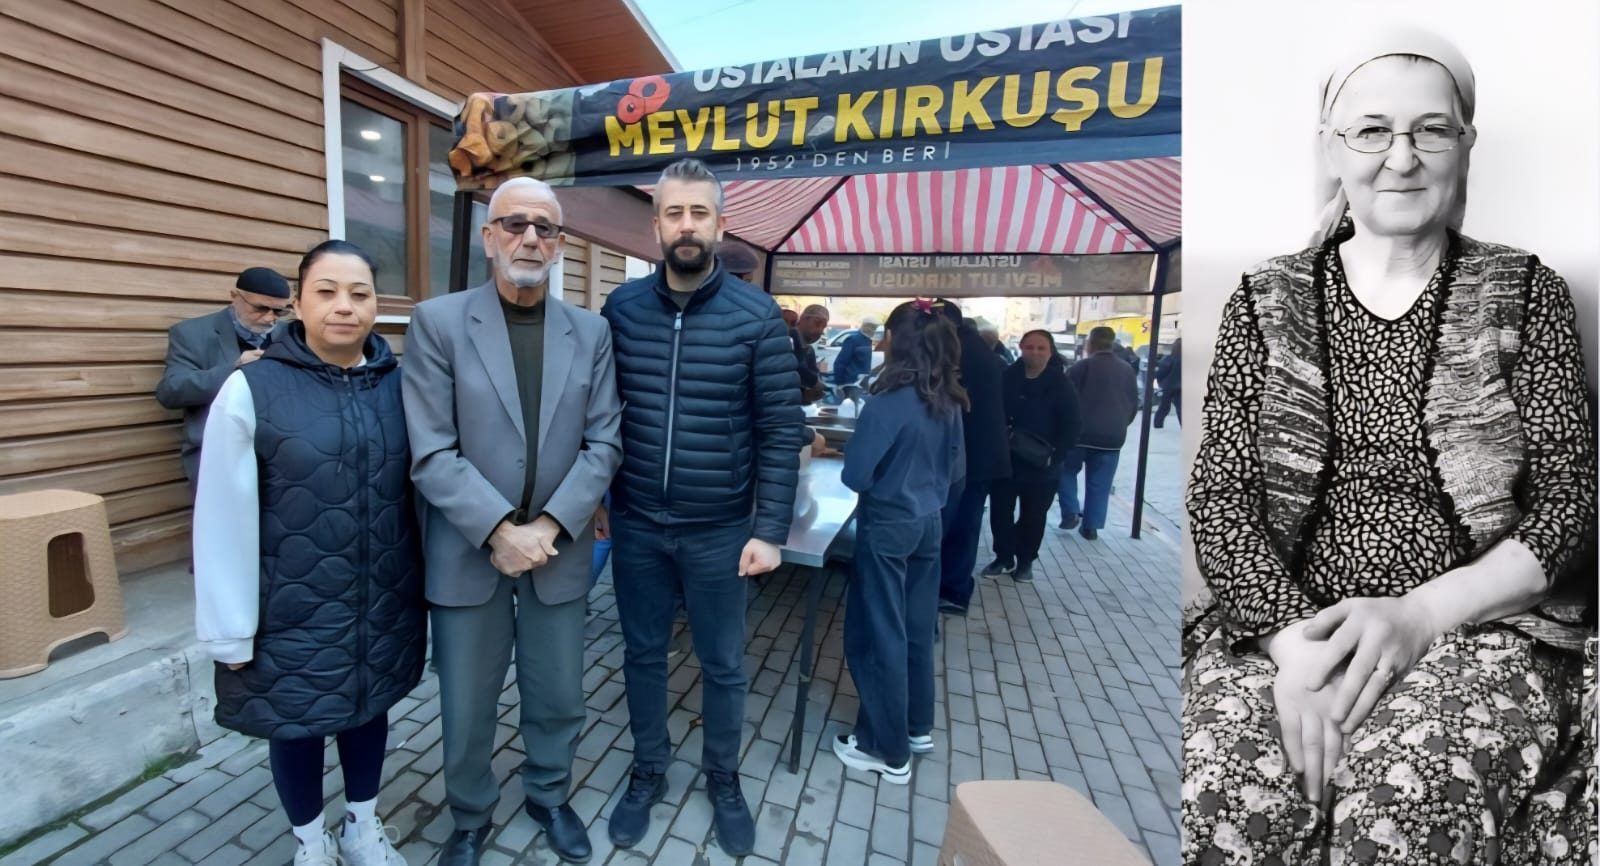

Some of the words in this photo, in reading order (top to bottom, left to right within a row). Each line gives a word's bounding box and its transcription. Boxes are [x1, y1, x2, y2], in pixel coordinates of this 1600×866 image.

[939, 11, 1132, 62] USTASI
[605, 96, 819, 157] MEVLUT
[834, 56, 1164, 144] KIRKUŞU
